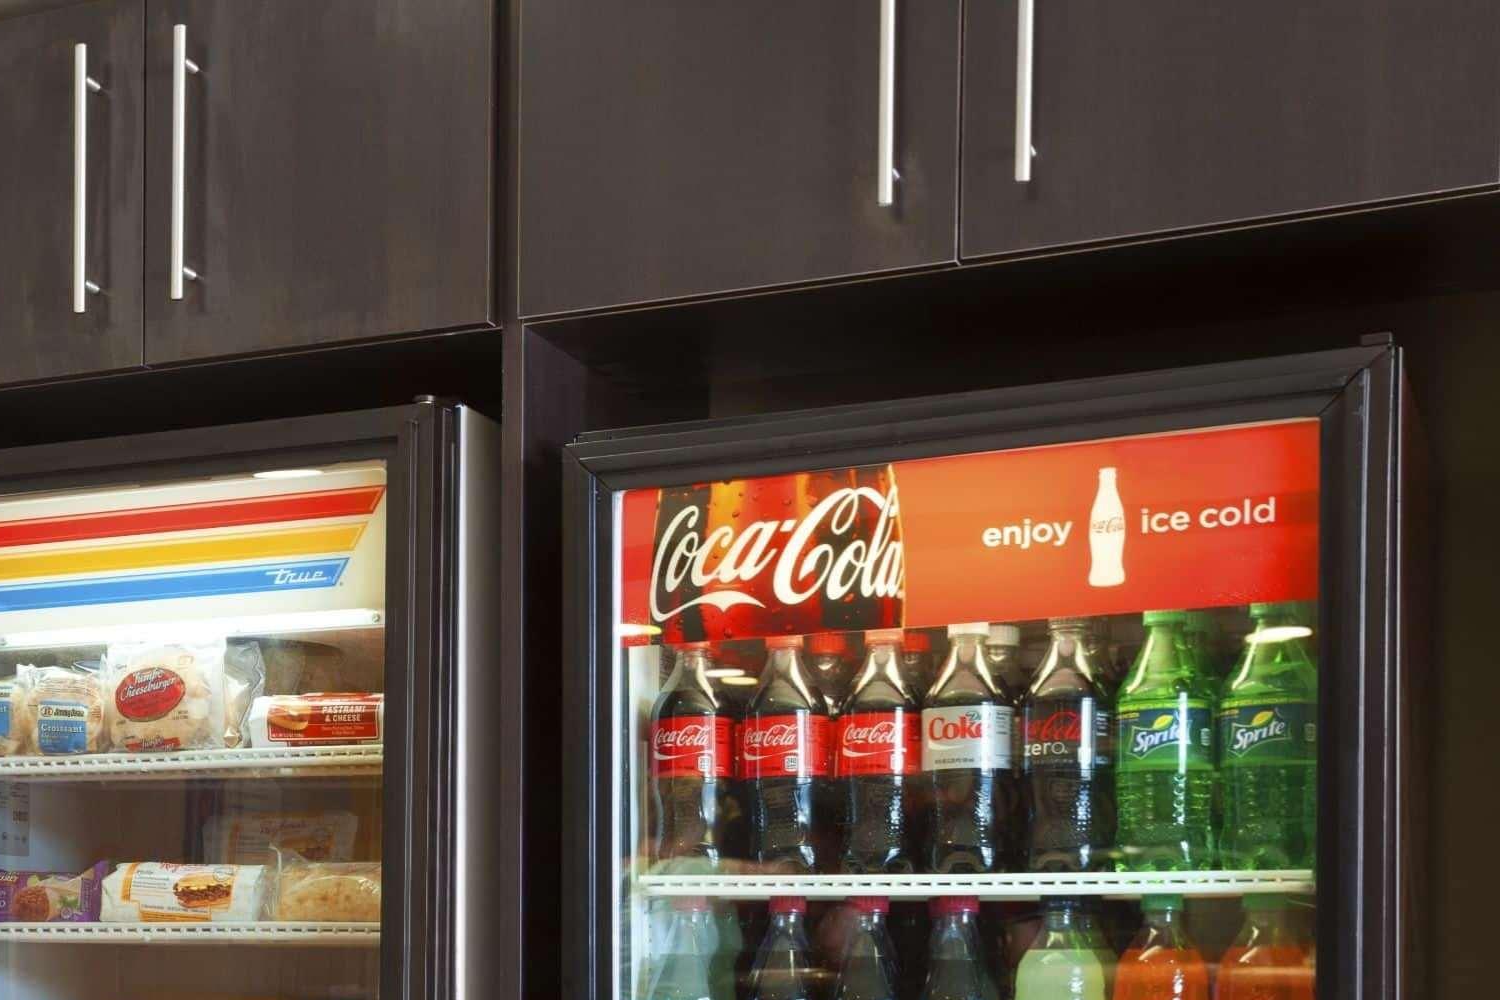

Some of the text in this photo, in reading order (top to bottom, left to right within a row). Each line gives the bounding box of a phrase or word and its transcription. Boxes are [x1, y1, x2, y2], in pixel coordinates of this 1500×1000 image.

[981, 496, 1277, 550] enjoy ice cold
[650, 486, 905, 622] Coca-Cola
[120, 676, 177, 702] Cheeseburger
[322, 705, 366, 714] PASTRAMI
[332, 714, 362, 722] CHEESE
[1233, 718, 1286, 750] Sprite
